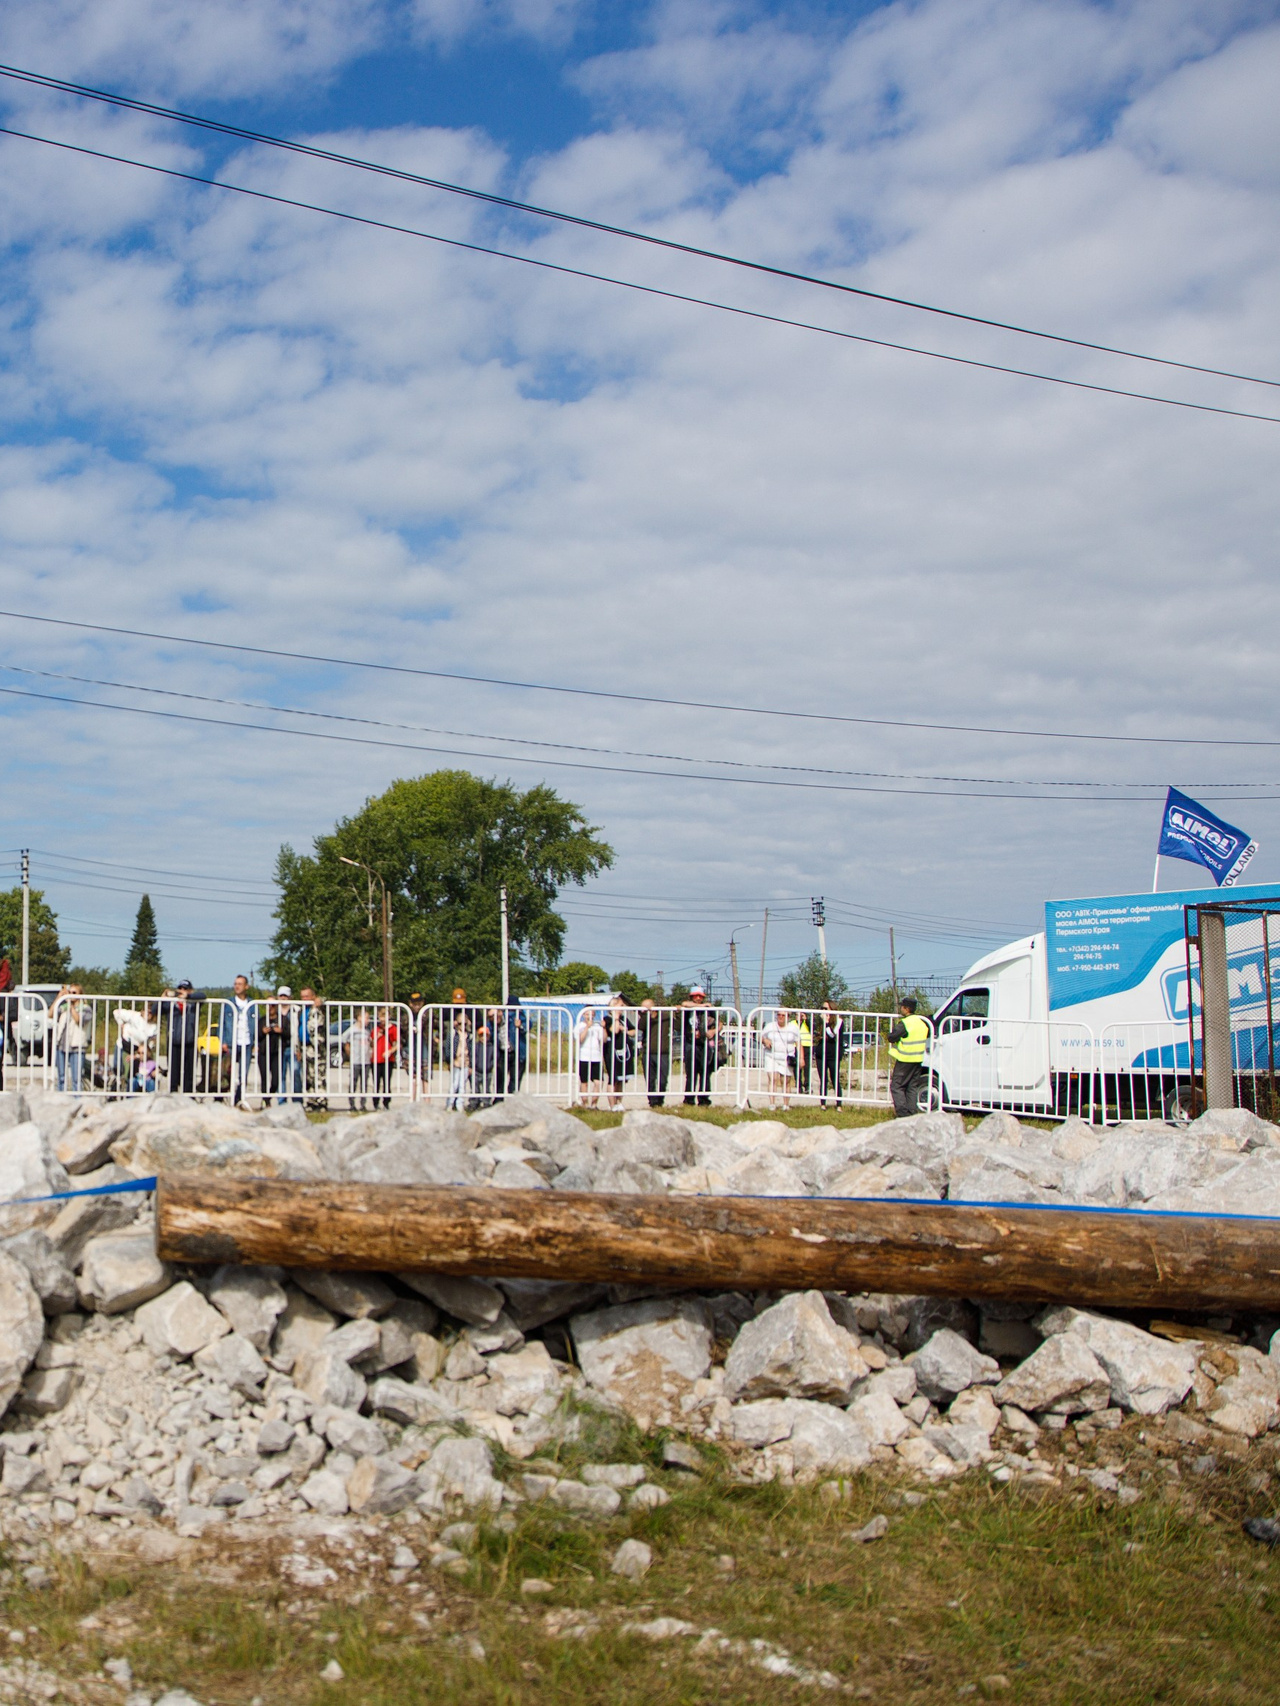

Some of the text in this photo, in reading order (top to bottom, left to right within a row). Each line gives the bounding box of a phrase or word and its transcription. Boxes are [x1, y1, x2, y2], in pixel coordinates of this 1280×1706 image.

[1171, 812, 1230, 855] AIMOL
[1221, 845, 1256, 887] OLLAND
[1055, 911, 1072, 919] ООО
[1130, 903, 1180, 914] официальный
[1078, 918, 1099, 926] AIMOL
[1110, 916, 1150, 924] территории
[1056, 926, 1110, 936] Пермского Края
